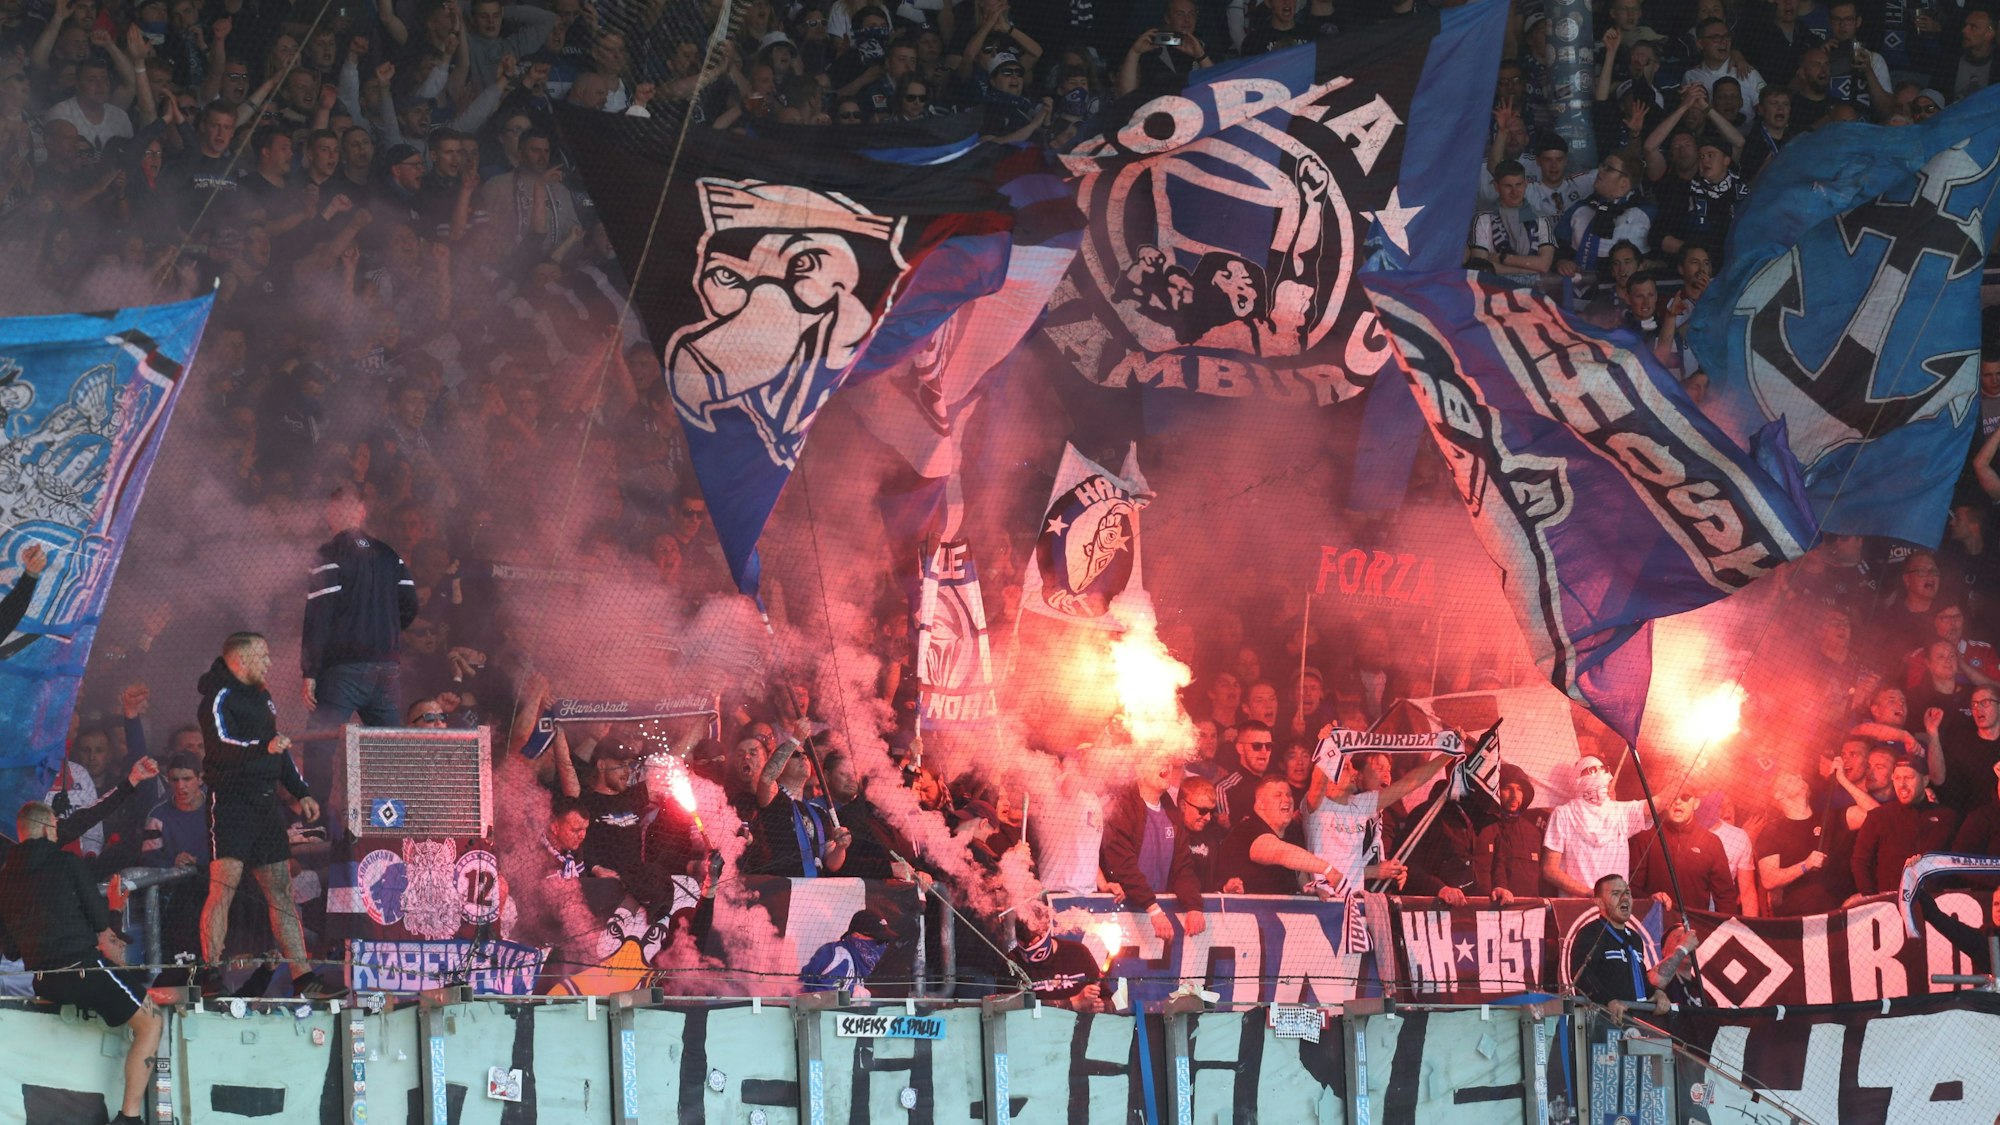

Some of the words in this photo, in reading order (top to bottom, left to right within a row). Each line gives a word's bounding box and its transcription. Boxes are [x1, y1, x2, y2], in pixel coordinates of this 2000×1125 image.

[1316, 545, 1435, 605] FORZA
[559, 699, 629, 716] Hansestadt
[1331, 730, 1438, 748] HAMBURGER
[465, 868, 493, 907] 12
[842, 1017, 887, 1035] SCHEISS
[431, 1039, 447, 1125] HANSAZONE
[622, 1031, 638, 1117] HANSAZONE
